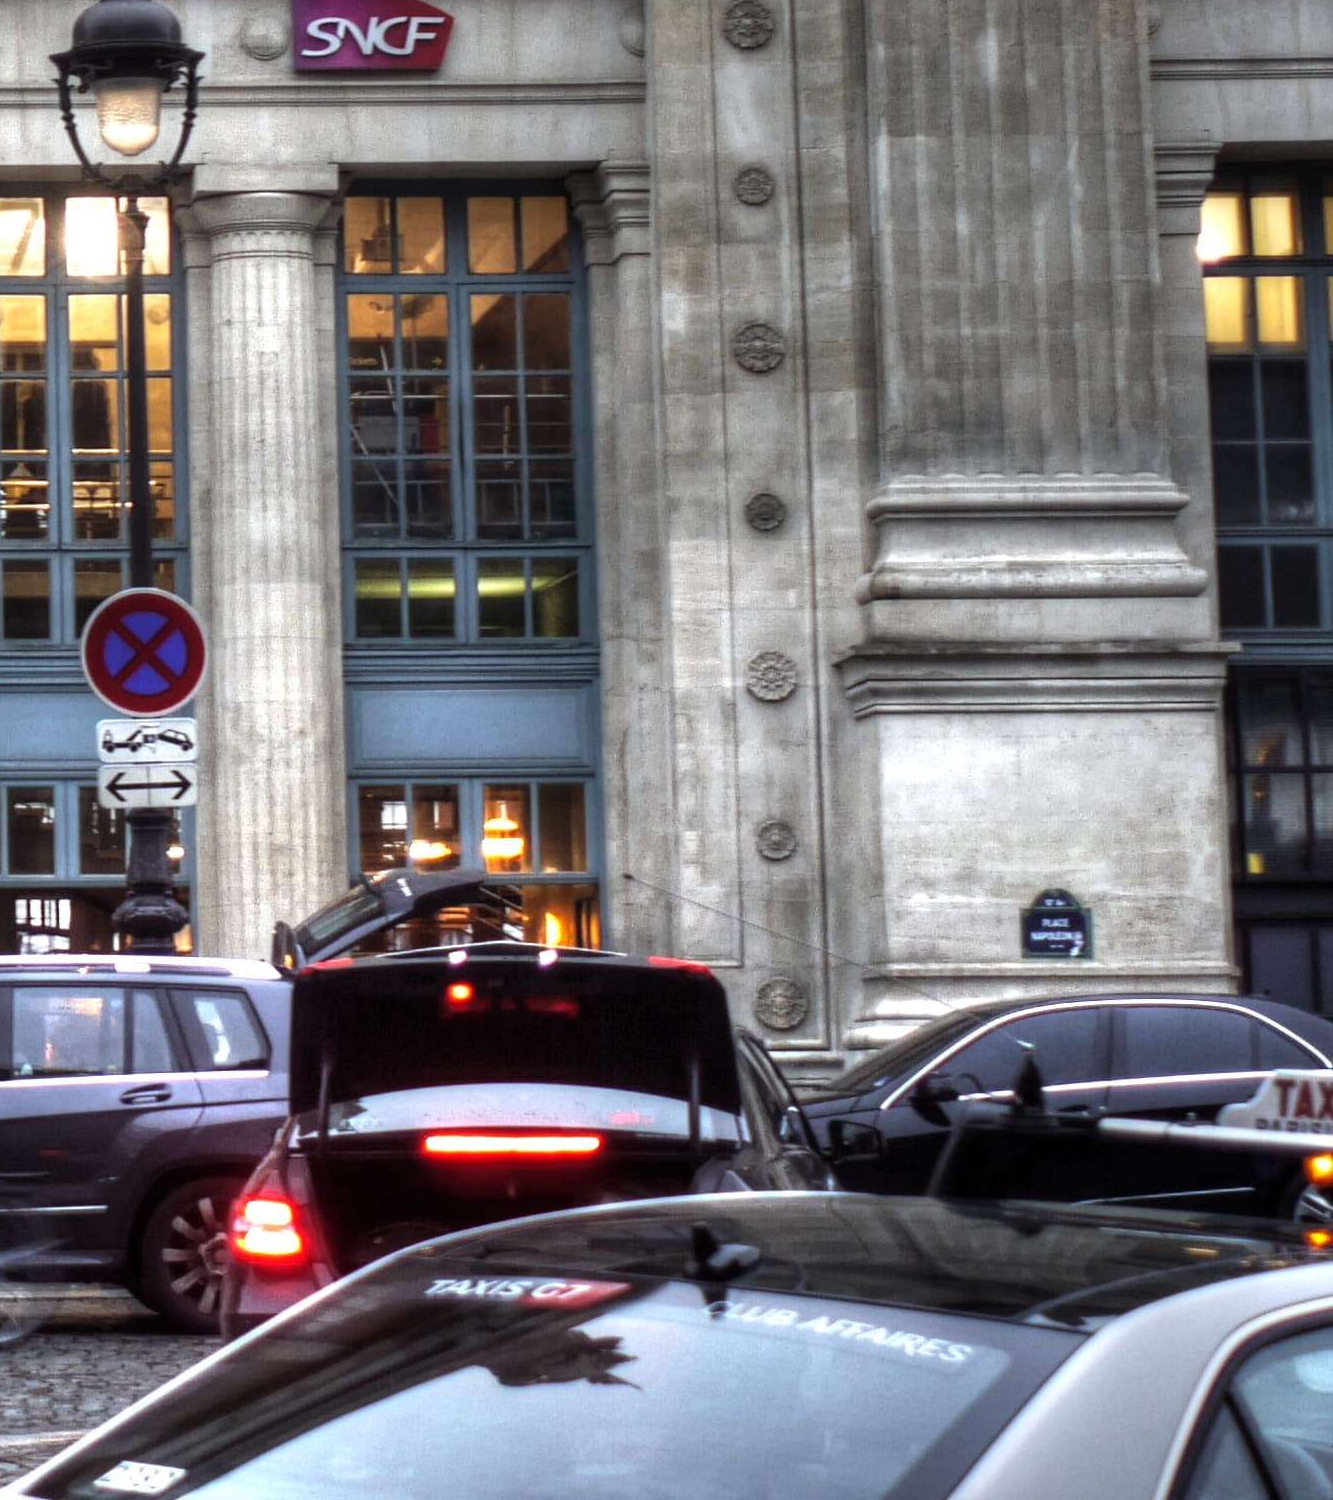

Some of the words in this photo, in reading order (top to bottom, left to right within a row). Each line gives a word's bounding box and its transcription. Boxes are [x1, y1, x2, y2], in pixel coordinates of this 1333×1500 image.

[301, 16, 446, 57] SNCF
[424, 1278, 533, 1297] TAXIS
[531, 1282, 593, 1299] G7
[704, 1300, 799, 1325] CLUB
[796, 1315, 974, 1363] AFFAIRES
